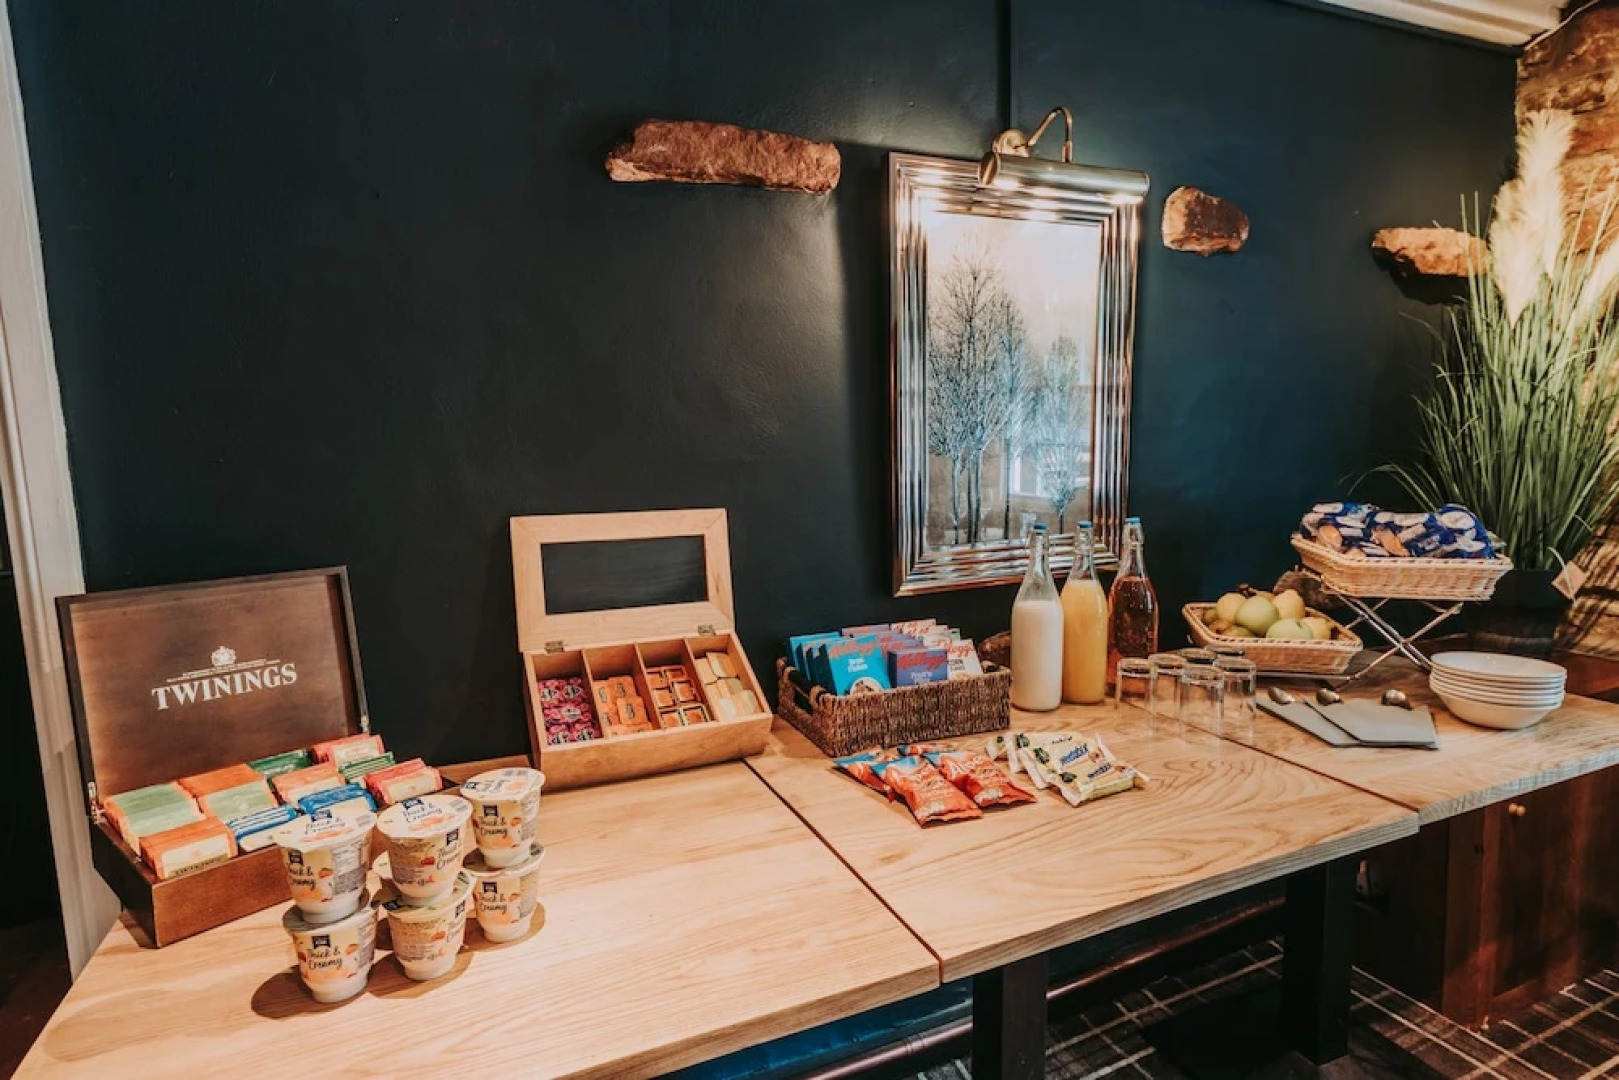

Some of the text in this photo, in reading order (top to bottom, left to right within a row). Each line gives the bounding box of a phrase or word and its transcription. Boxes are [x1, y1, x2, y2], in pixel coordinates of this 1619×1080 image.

[151, 663, 299, 711] TWININGS
[306, 945, 342, 959] Thick &
[308, 957, 343, 971] Creamy
